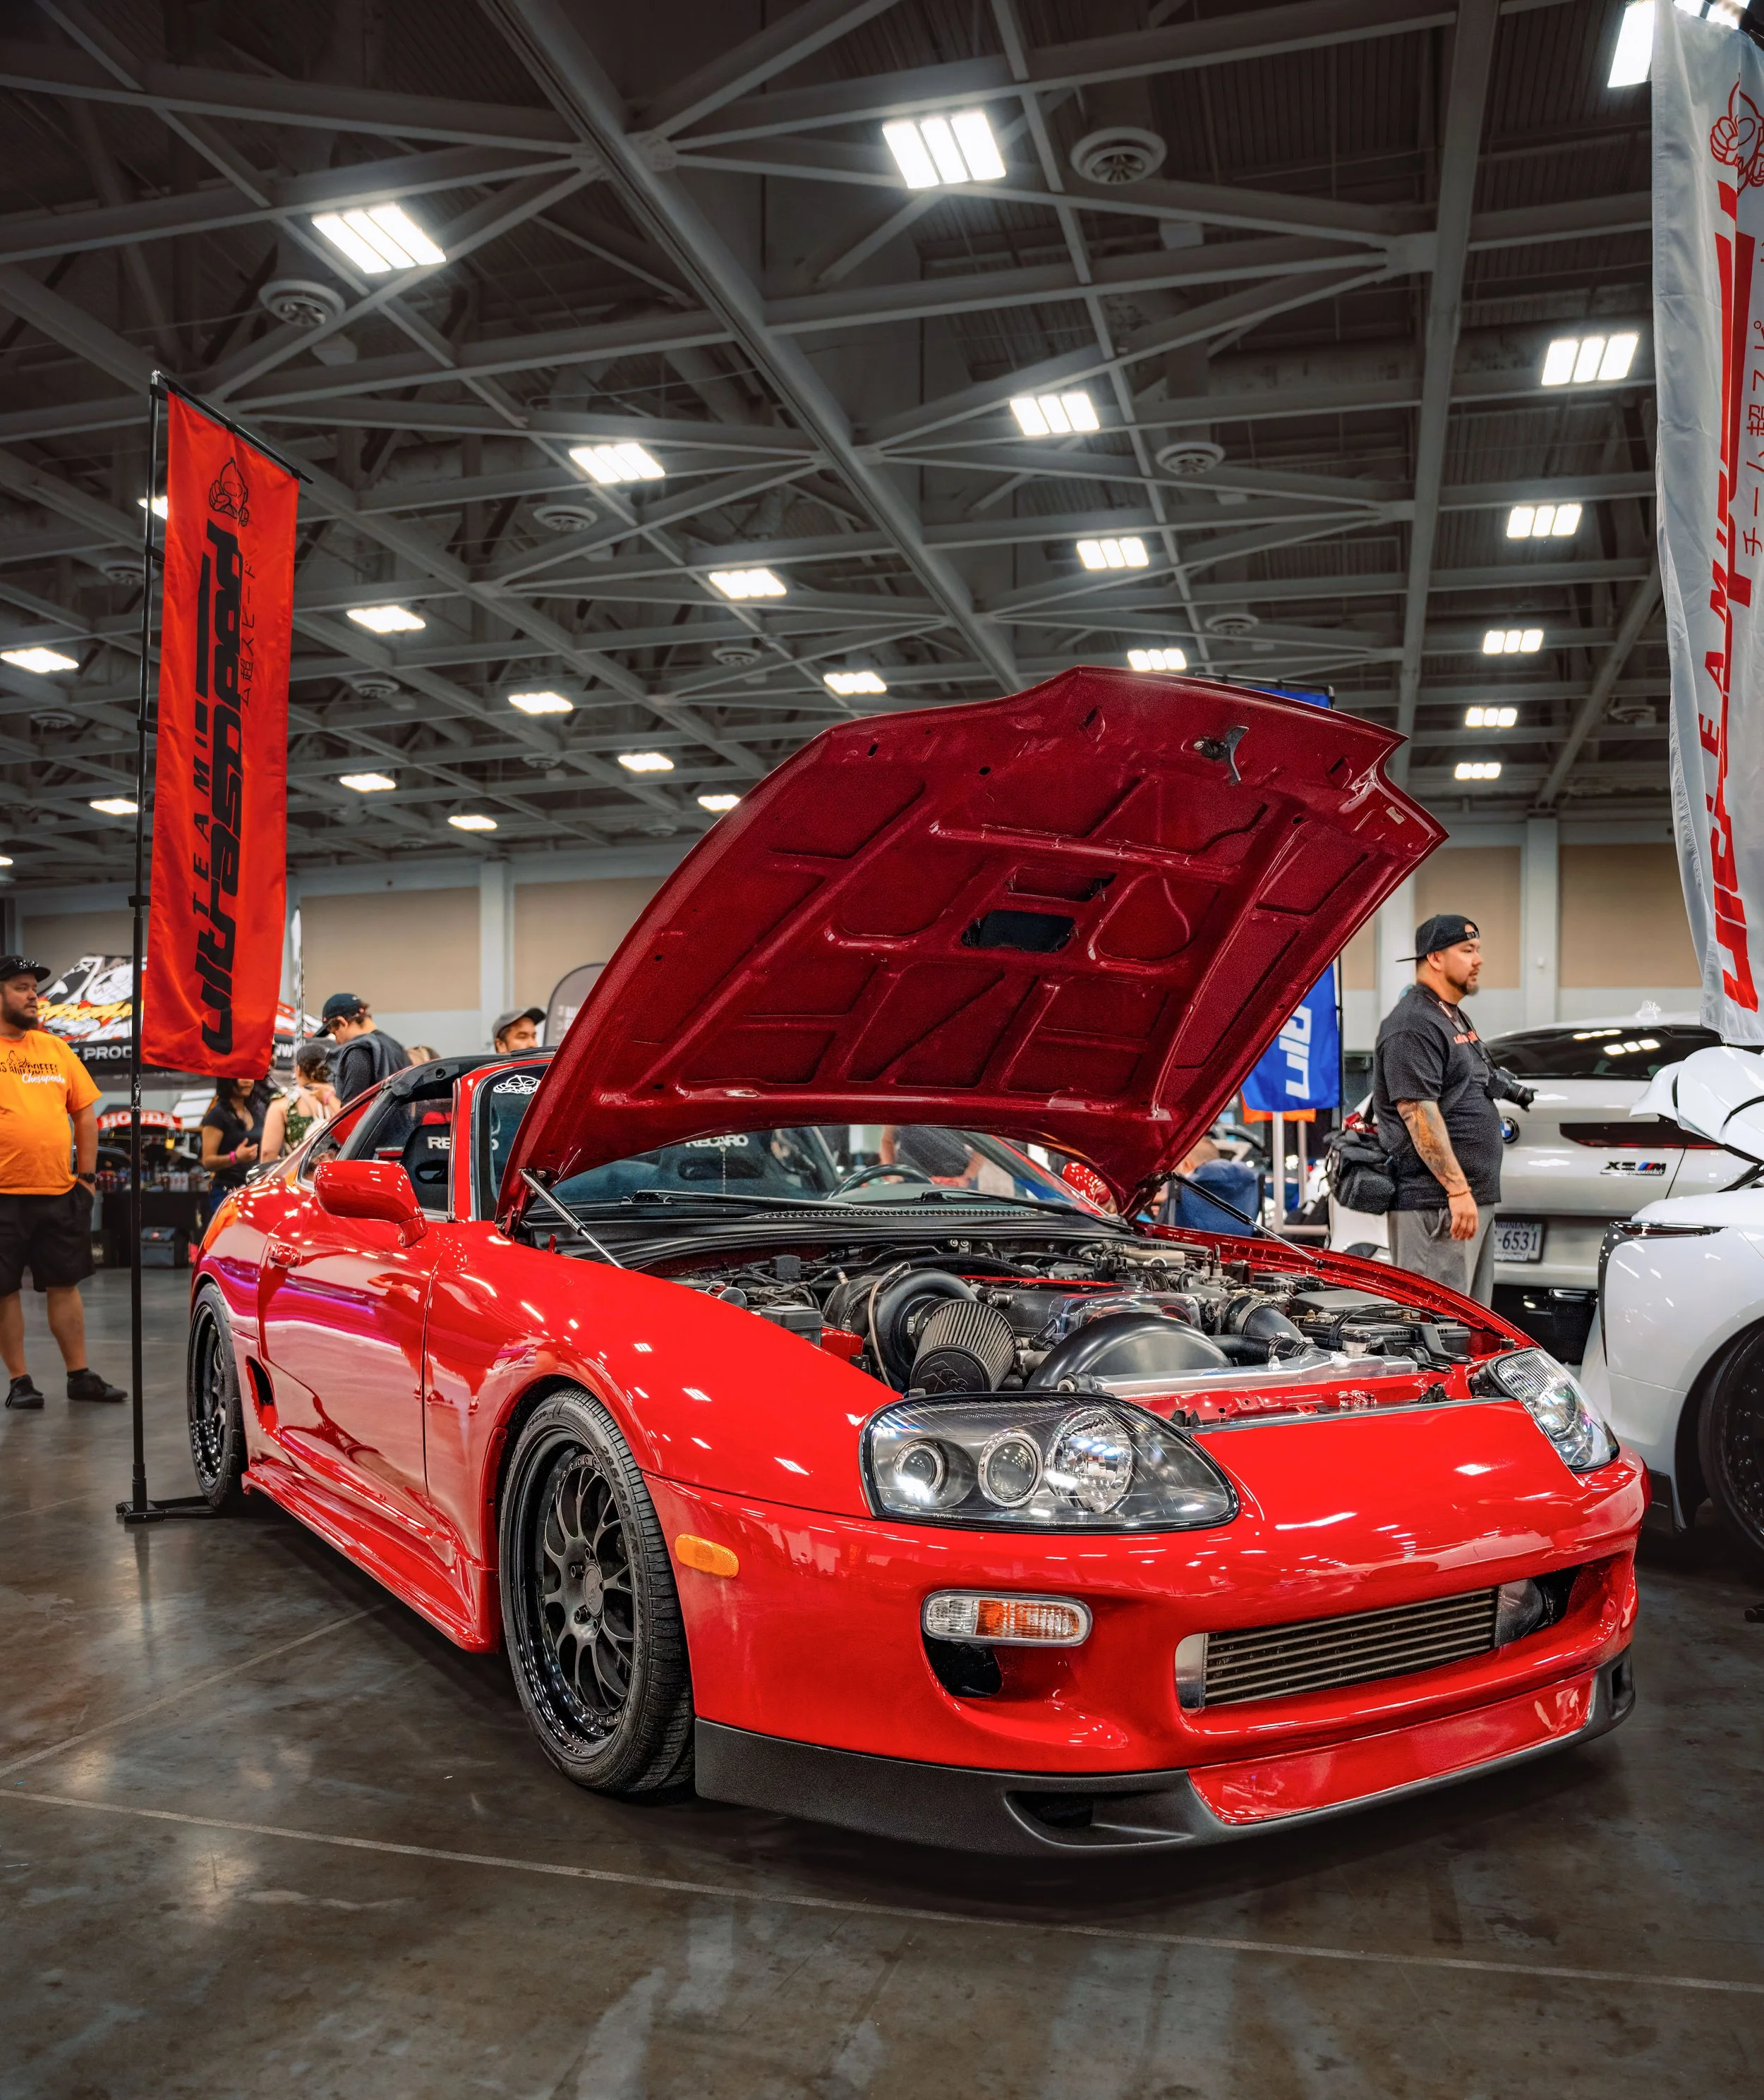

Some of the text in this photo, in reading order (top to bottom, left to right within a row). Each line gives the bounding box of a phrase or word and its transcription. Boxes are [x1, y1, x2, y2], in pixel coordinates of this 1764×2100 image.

[1698, 557, 1727, 813] EAM
[193, 763, 210, 918] TEAM
[1494, 1230, 1538, 1251] -6531
